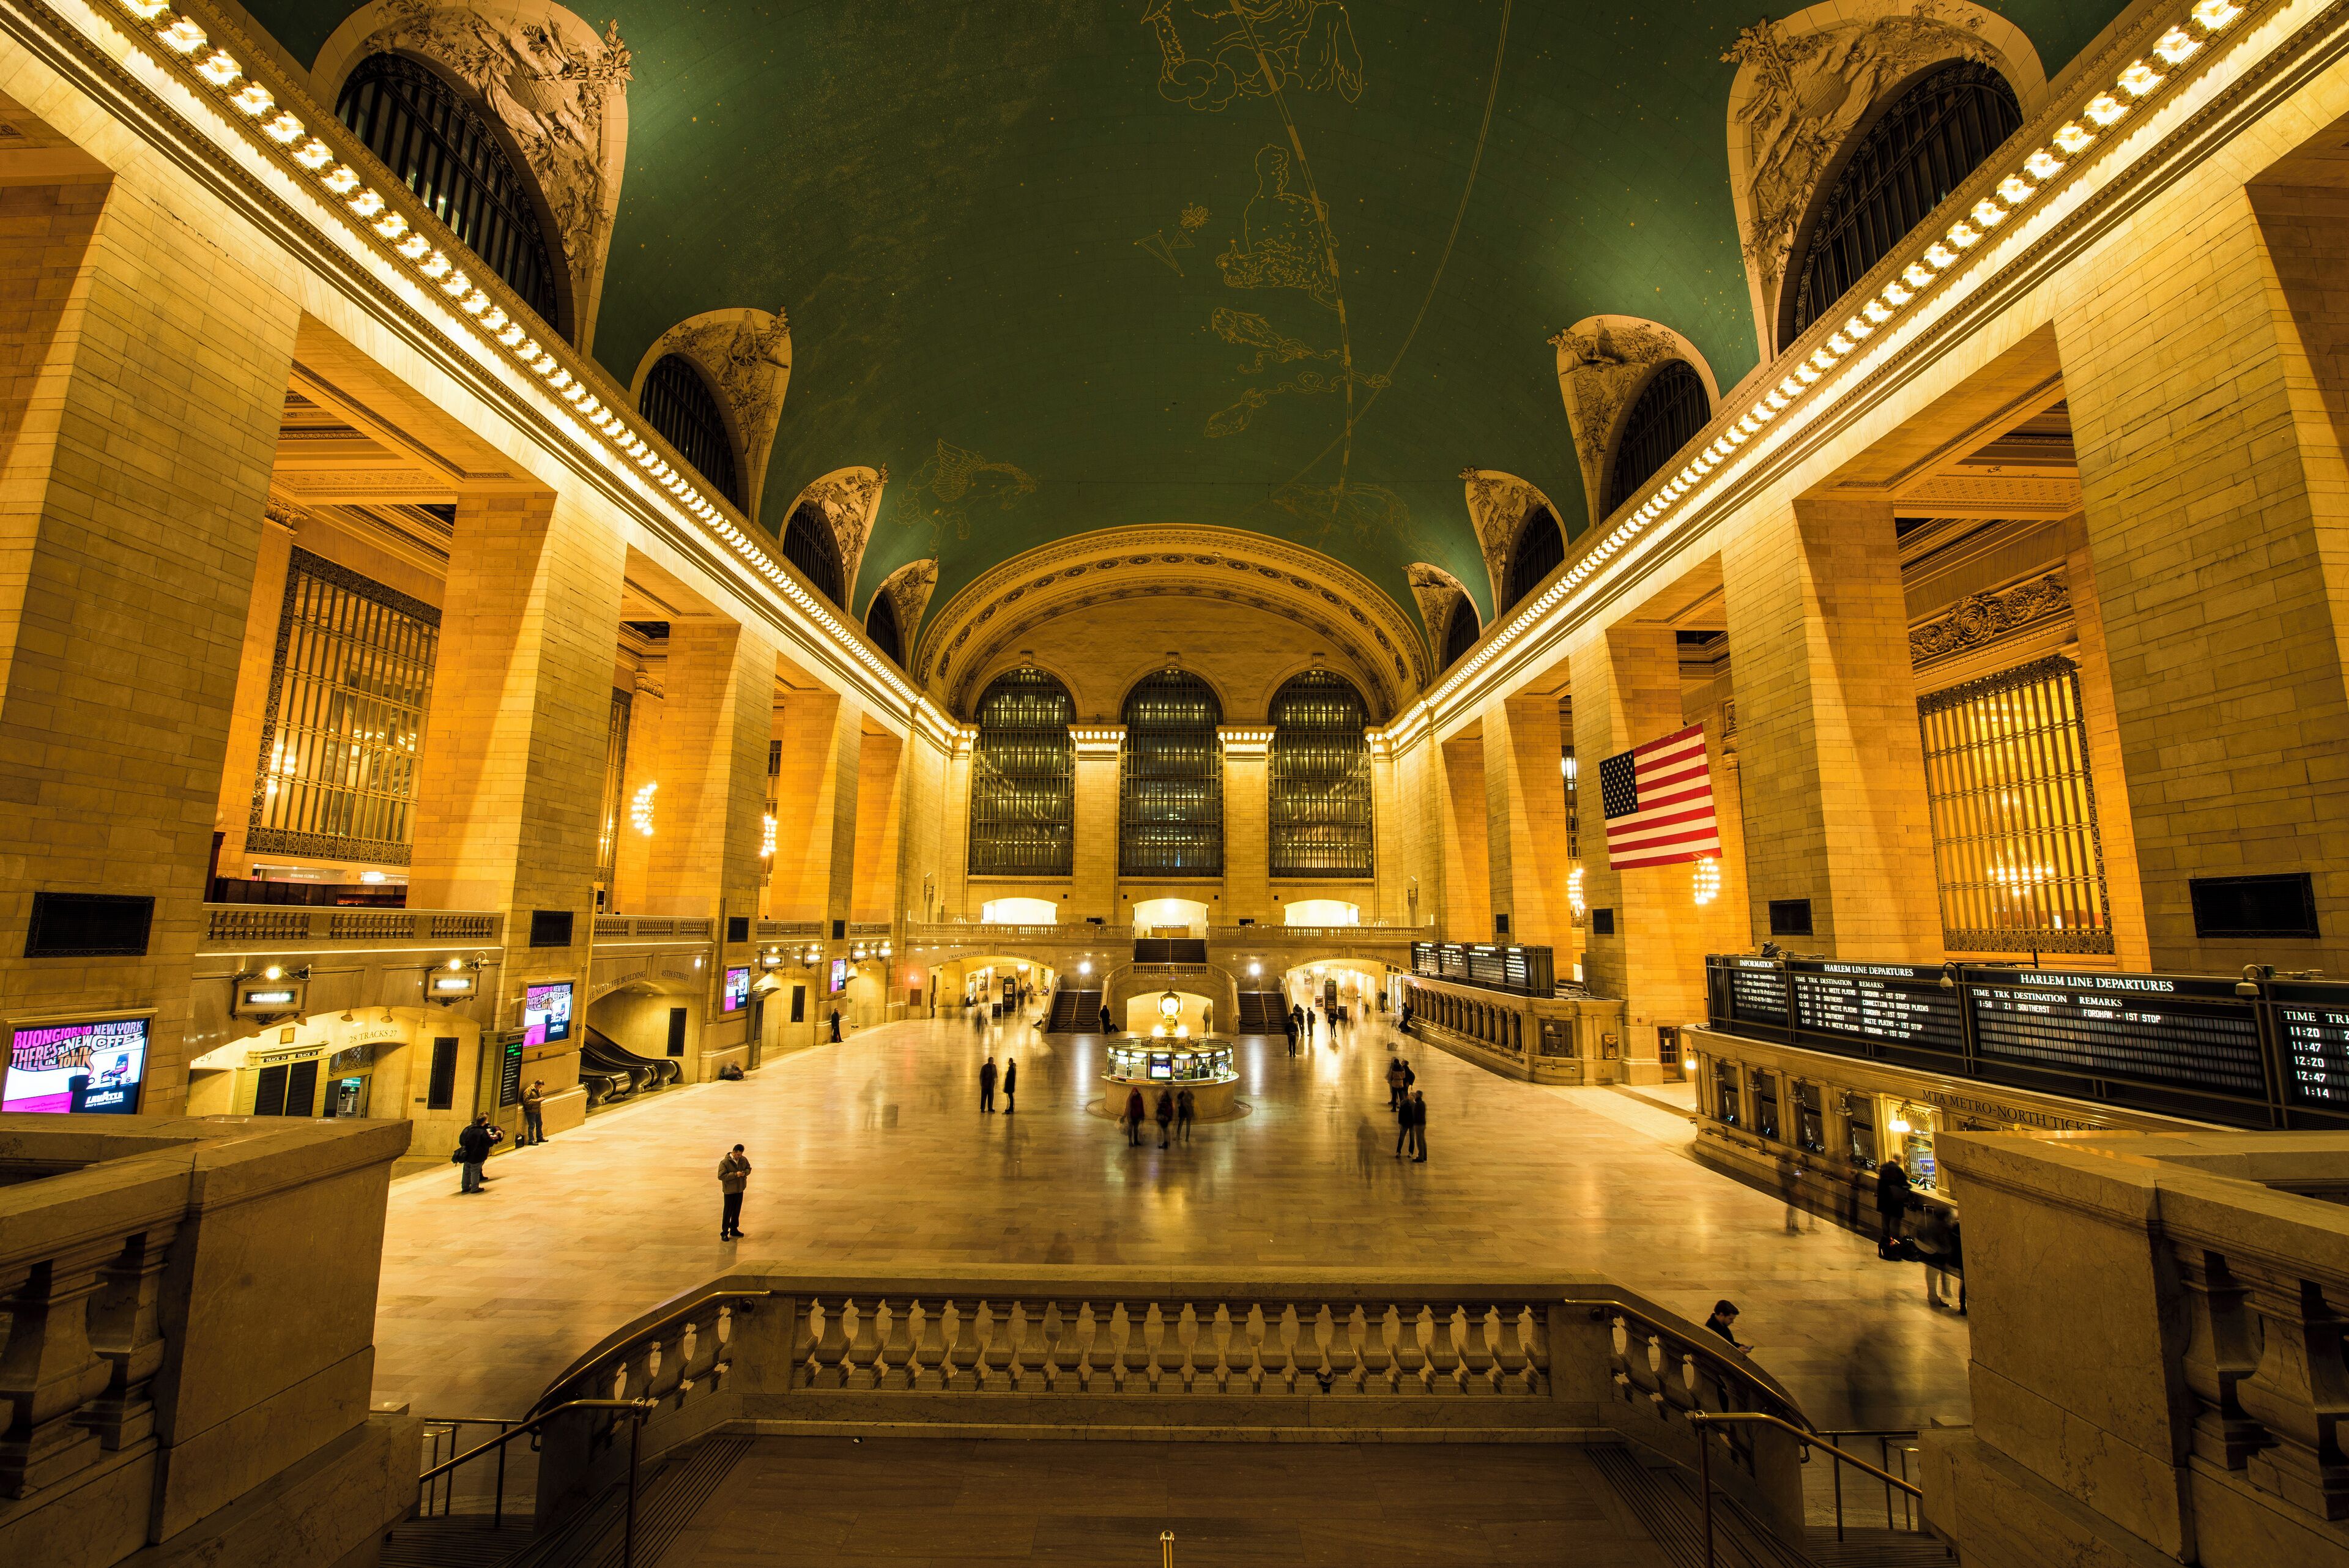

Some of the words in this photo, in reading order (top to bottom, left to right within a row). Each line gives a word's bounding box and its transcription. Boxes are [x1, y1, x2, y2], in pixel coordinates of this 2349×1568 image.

[1303, 954, 1330, 962] LEXINGTON
[1376, 956, 1400, 964] MACHINES
[674, 970, 689, 981] STREET
[1824, 964, 1851, 973] HARLEM
[1869, 967, 1913, 976] DEPARTURES
[596, 978, 620, 995] METLIFE
[621, 970, 646, 984] BUILDING
[2021, 974, 2065, 986] HARLEM
[2067, 976, 2093, 987] LINE
[2096, 978, 2174, 992] DEPARTURES
[1862, 999, 1887, 1008] CONNECTION
[1994, 990, 2010, 998] TRK
[2014, 992, 2067, 1003] DESTINATION
[2079, 997, 2123, 1007] REMARKS
[2017, 1003, 2050, 1013] SOUTHEAST
[2083, 1009, 2113, 1019] FORDHAM
[2125, 1013, 2137, 1021] 1ST
[2142, 1014, 2161, 1023] STOP
[2284, 1011, 2316, 1022] TIME
[13, 1025, 92, 1049] BUONGIORNO
[93, 1024, 117, 1035] NEW
[116, 1021, 144, 1034] YORK
[359, 1030, 388, 1040] TRACKS
[1865, 1027, 1882, 1035] FORDHAM
[2290, 1026, 2320, 1038] 11:20
[63, 1034, 94, 1050] NEW
[91, 1031, 143, 1052] COFFEE
[2292, 1041, 2321, 1052] 11:47
[45, 1057, 57, 1066] IN
[2295, 1055, 2325, 1068] 12:20
[2296, 1071, 2326, 1082] 12:47
[2304, 1086, 2330, 1098] 1:14
[1922, 1089, 1946, 1104] MTA
[1949, 1094, 2047, 1127] METRO-NORTH
[2050, 1116, 2113, 1131] TICKE
